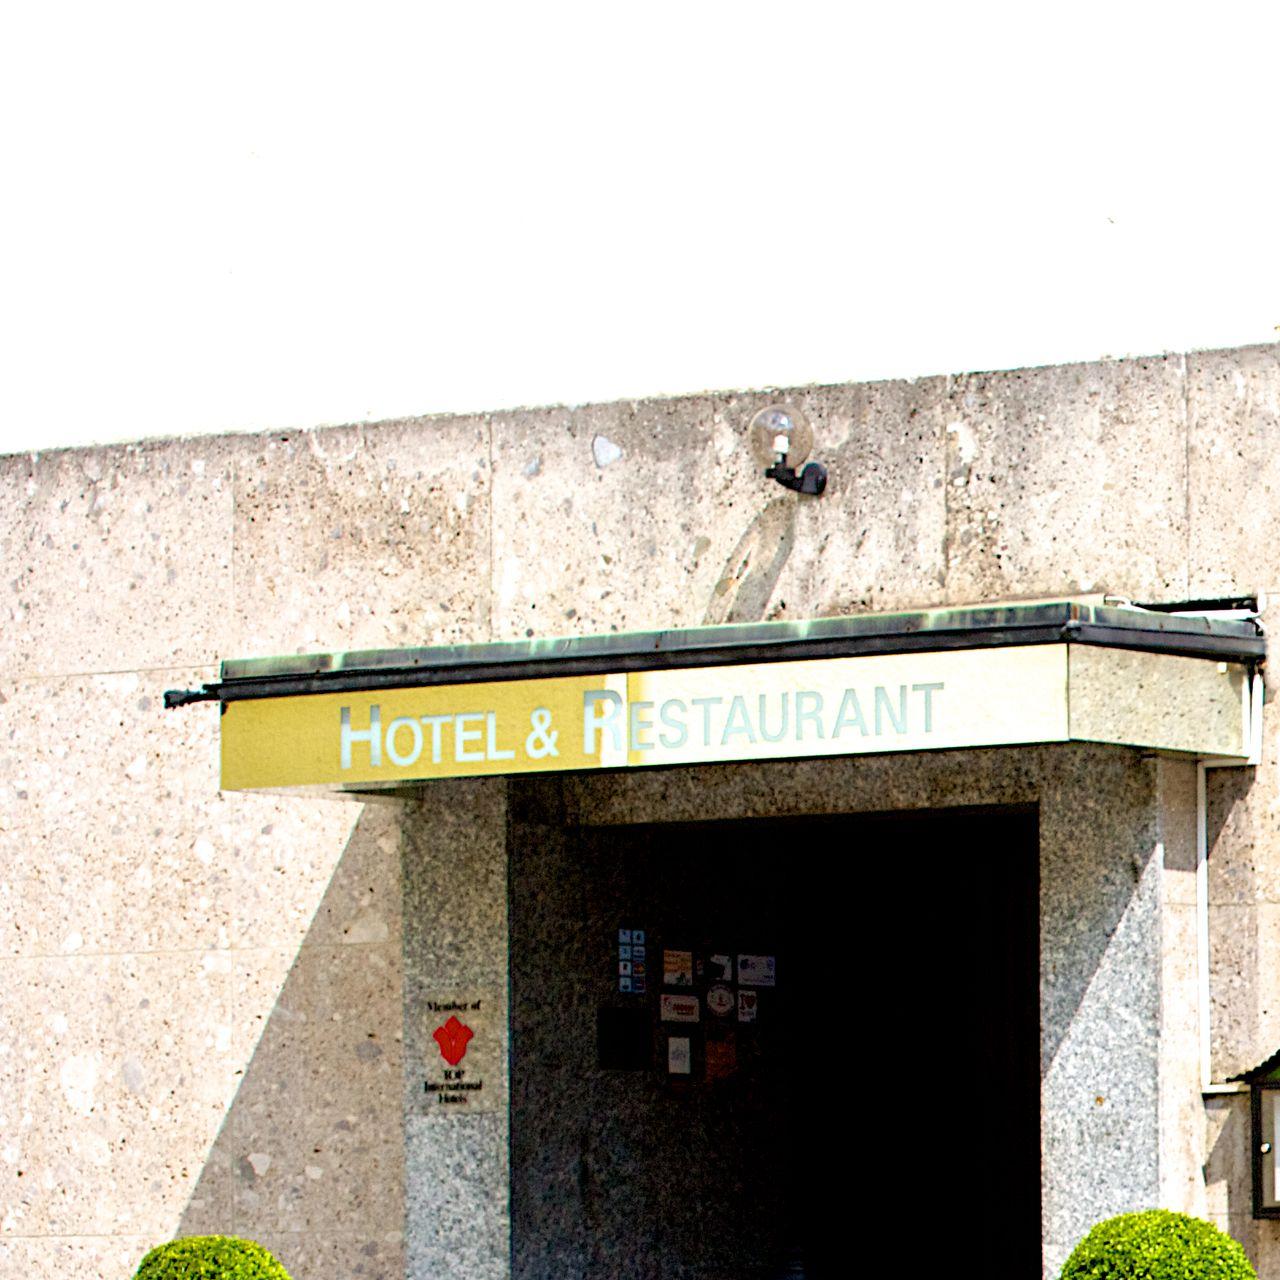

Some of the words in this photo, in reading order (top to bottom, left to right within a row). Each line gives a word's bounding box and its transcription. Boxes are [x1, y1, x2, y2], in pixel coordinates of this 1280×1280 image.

[341, 703, 515, 770] HOTEL
[526, 710, 560, 758] &
[583, 682, 946, 755] RESTAURANT
